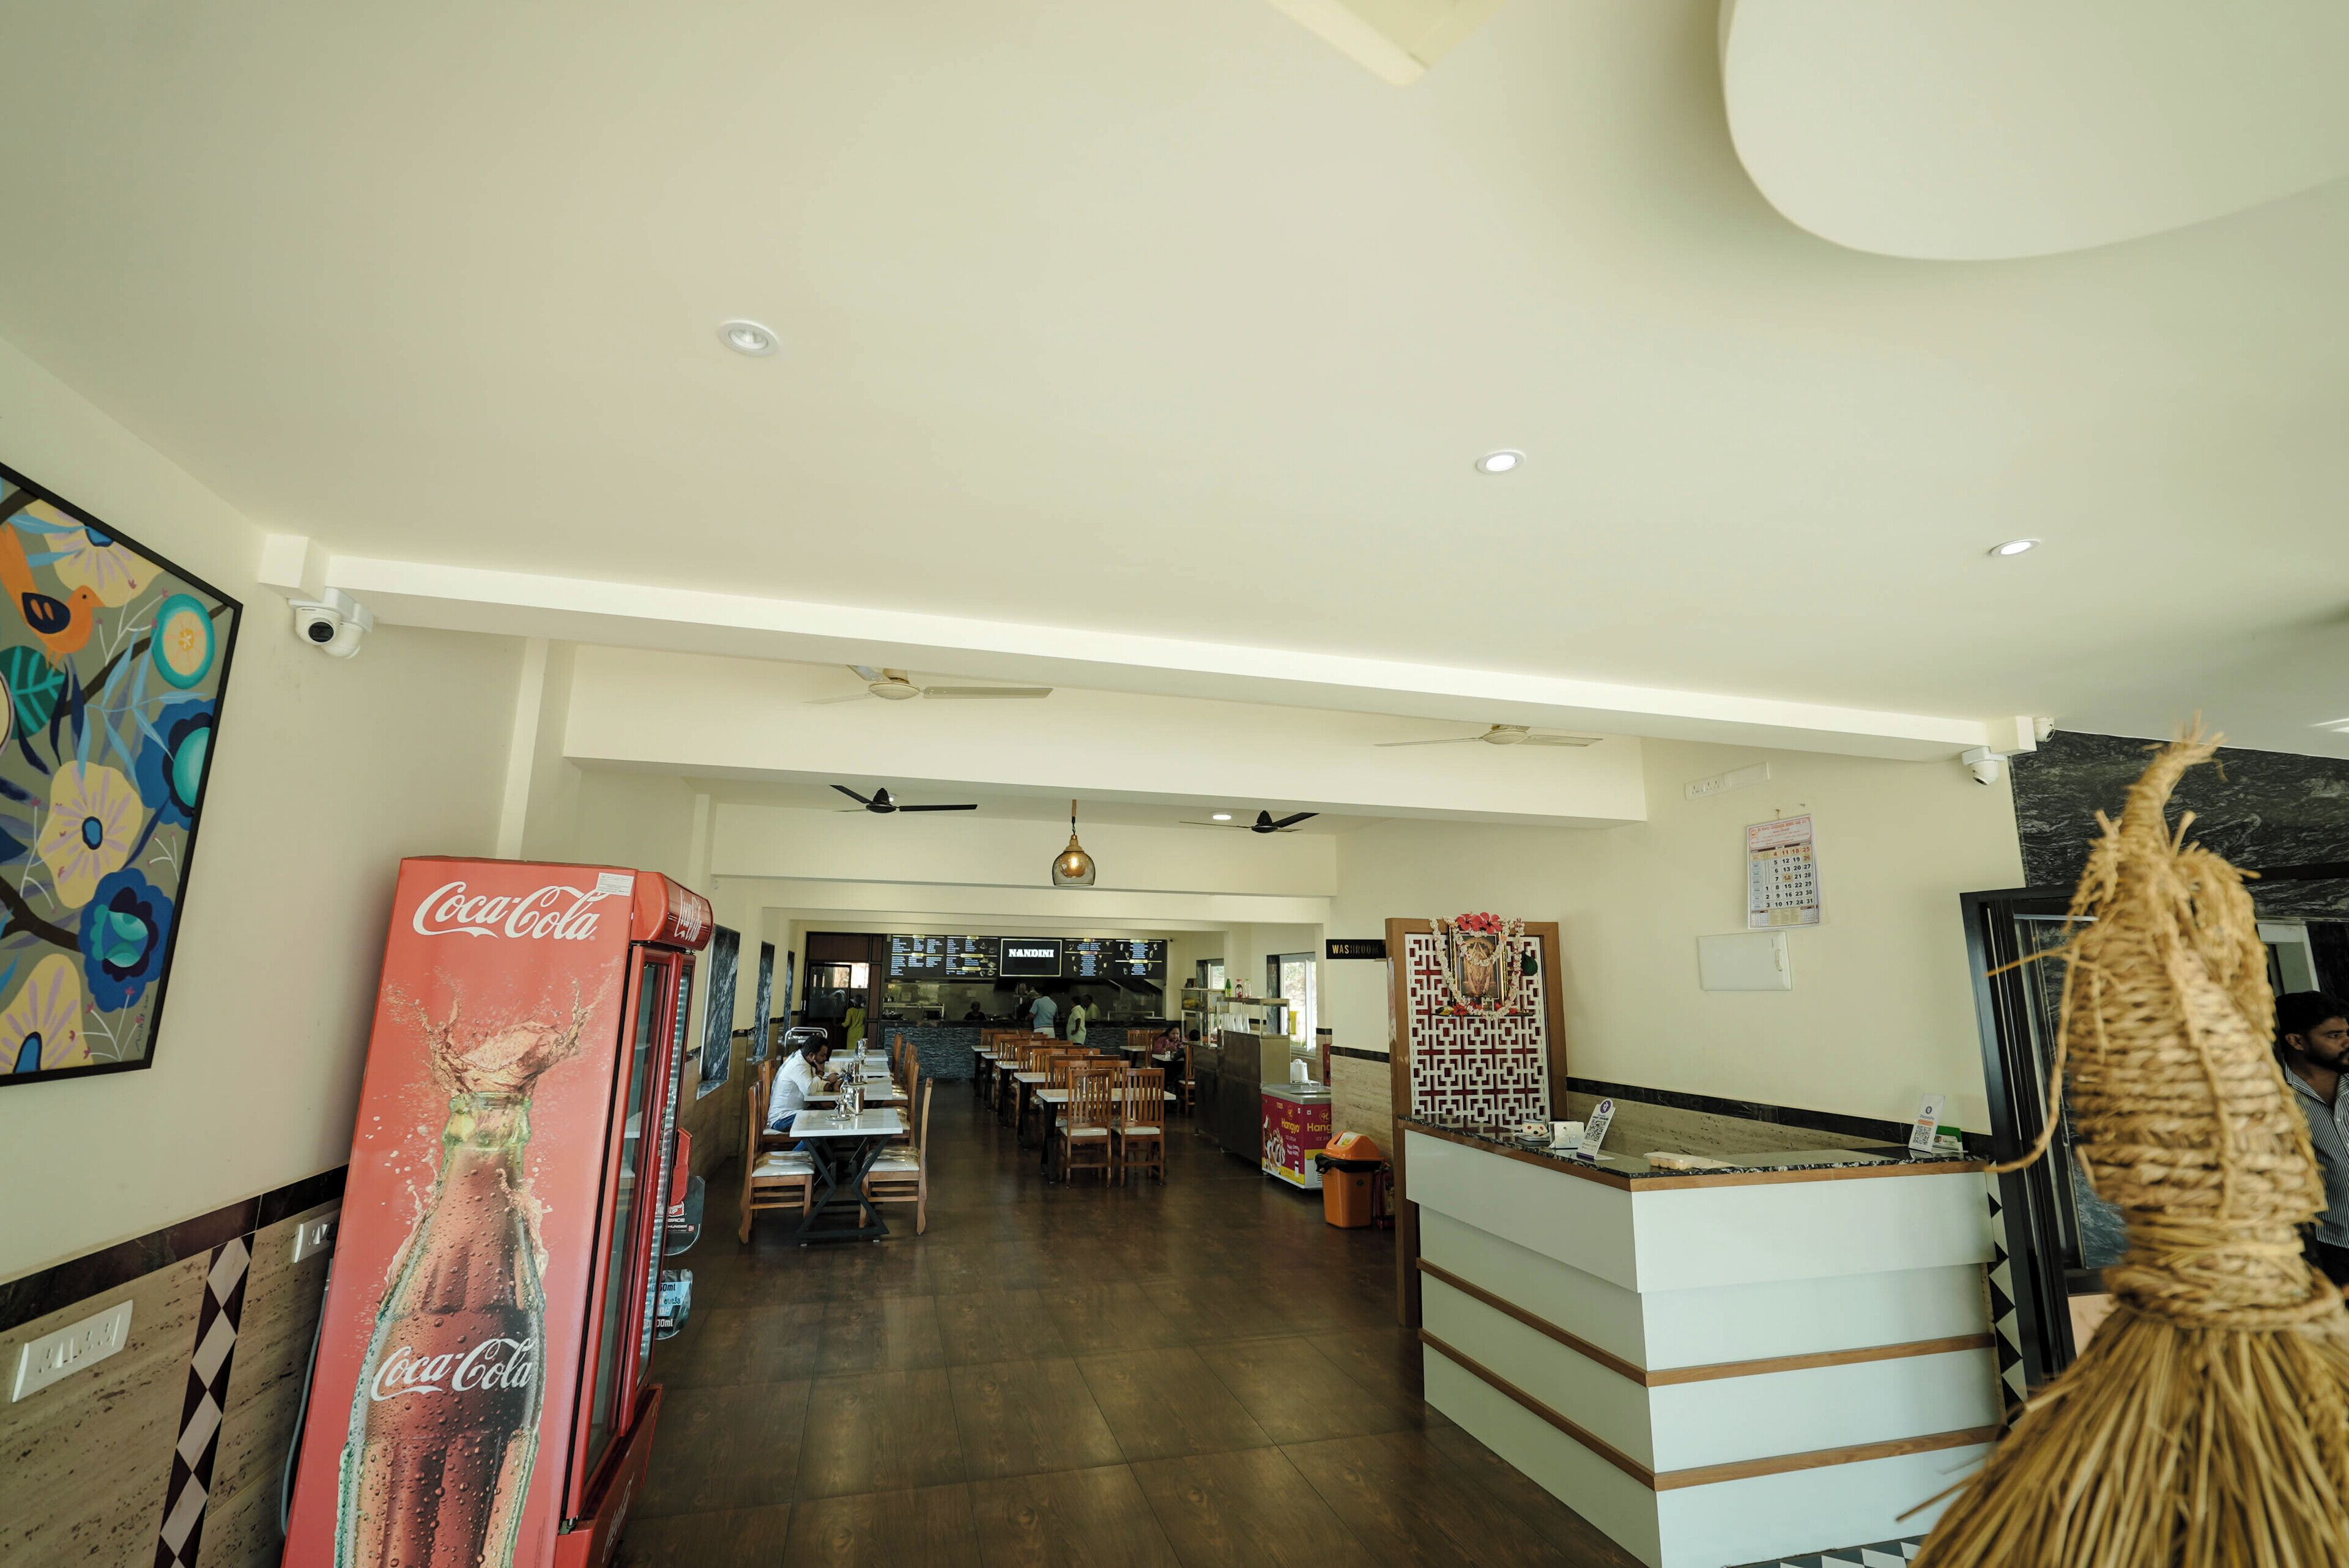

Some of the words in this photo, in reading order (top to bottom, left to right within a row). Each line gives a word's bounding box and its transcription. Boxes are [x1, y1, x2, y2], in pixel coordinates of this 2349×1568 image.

[413, 881, 612, 940] Coca-Cola
[1008, 949, 1054, 958] NANDINI
[1282, 1118, 1300, 1134] Hangyo
[371, 1337, 537, 1401] Coca-Cola
